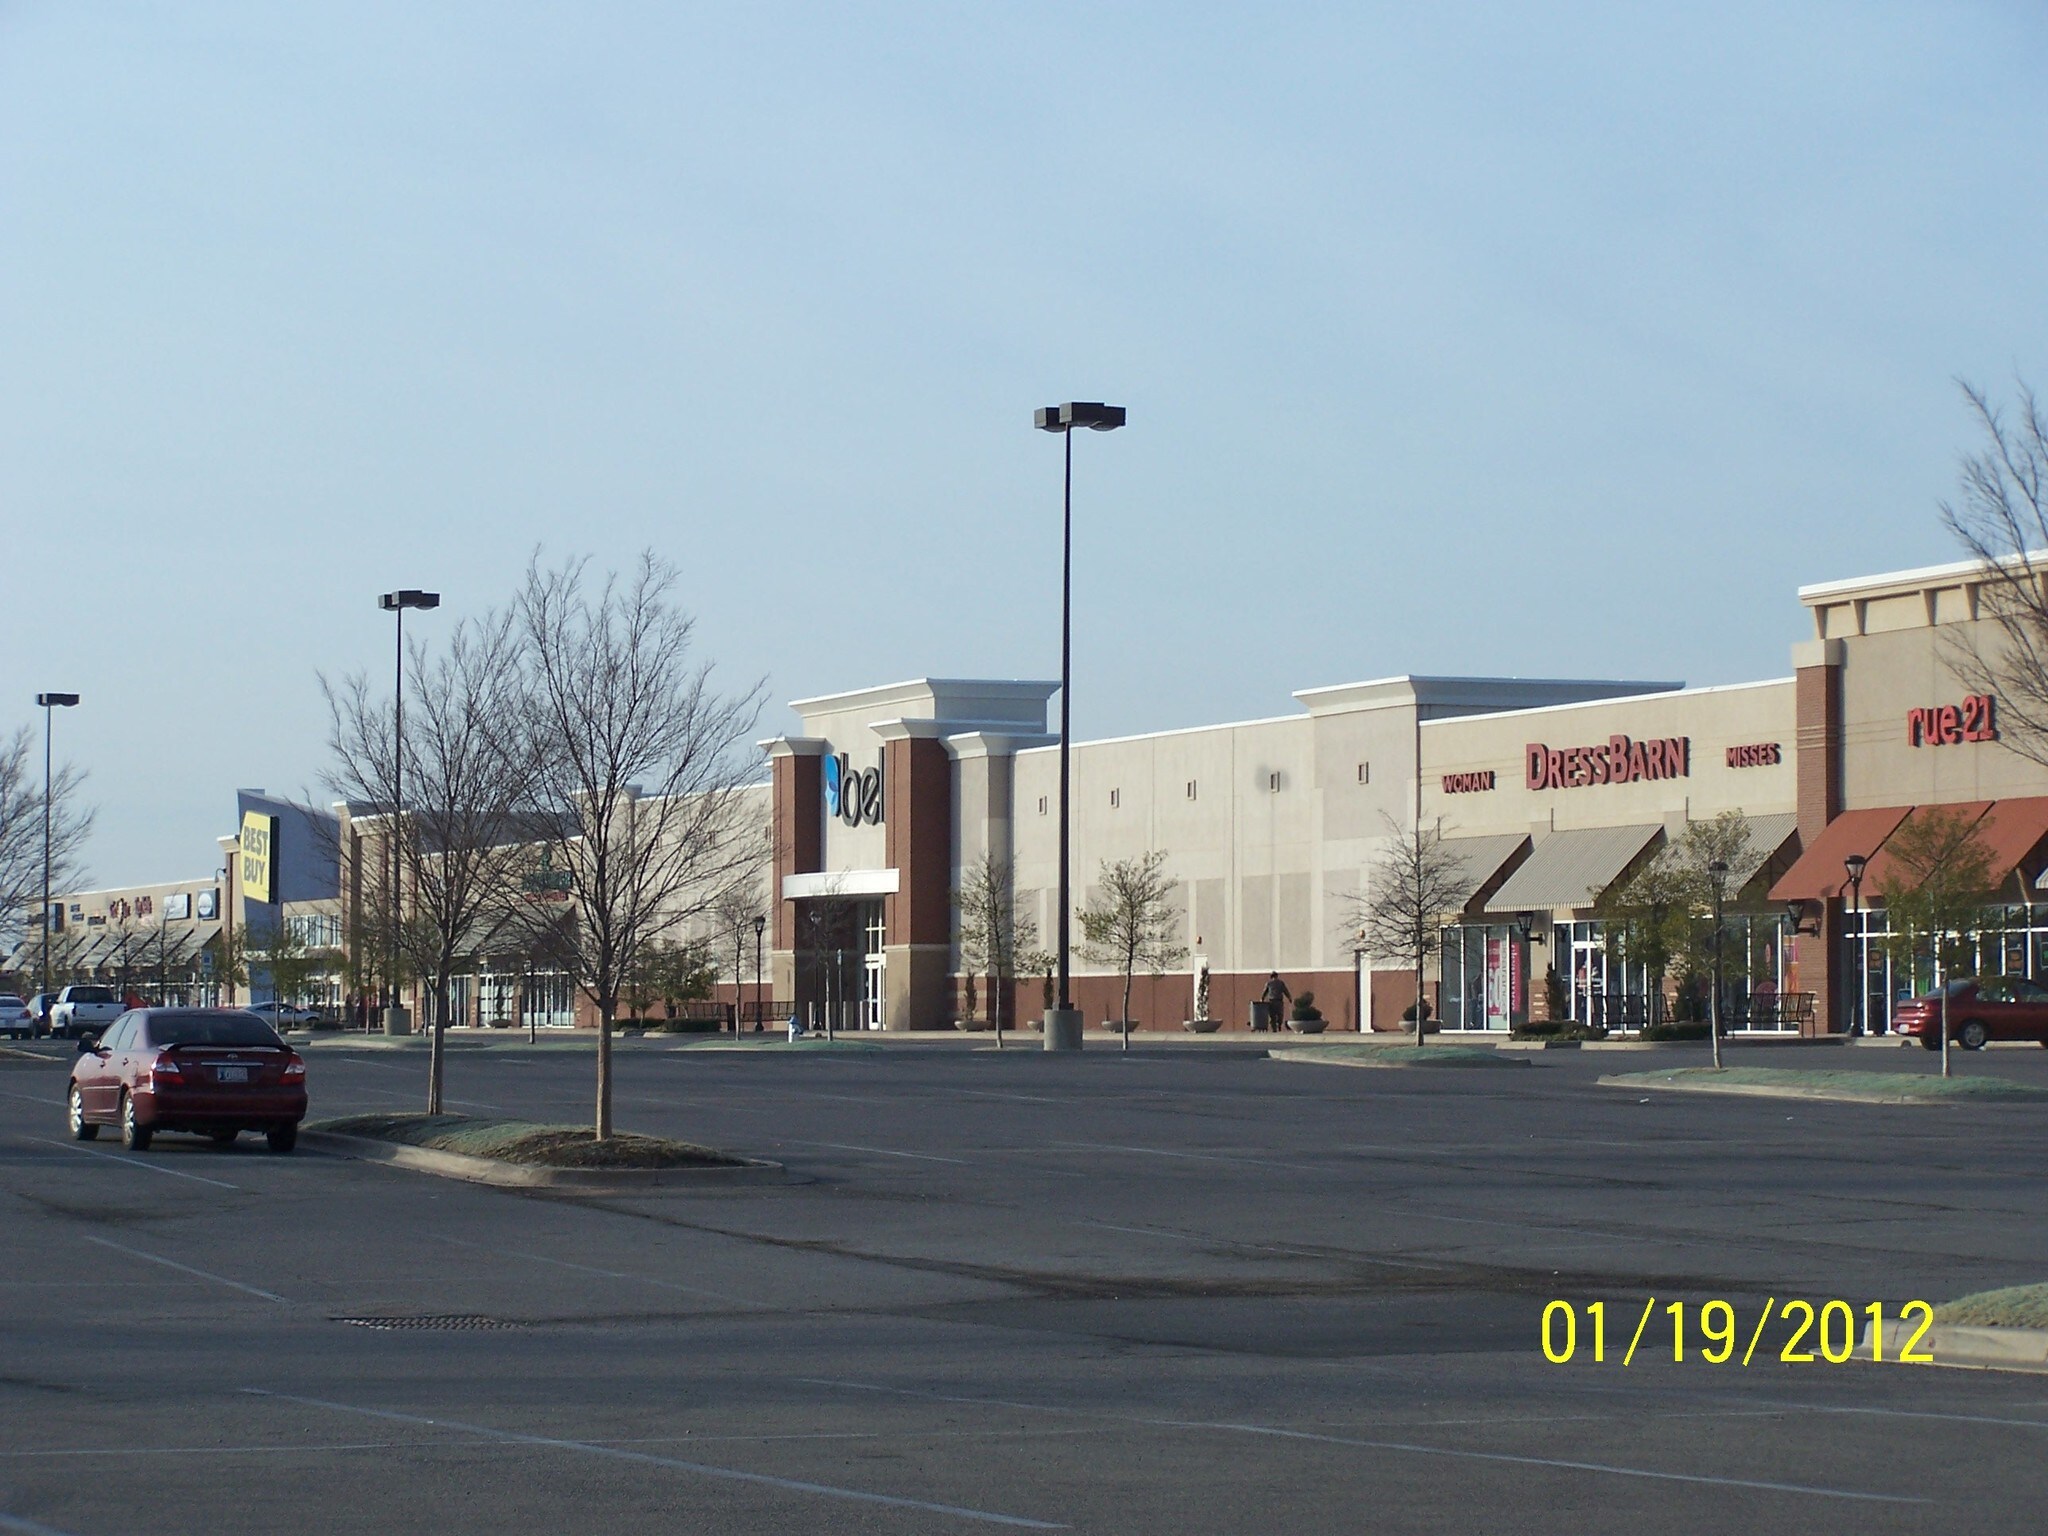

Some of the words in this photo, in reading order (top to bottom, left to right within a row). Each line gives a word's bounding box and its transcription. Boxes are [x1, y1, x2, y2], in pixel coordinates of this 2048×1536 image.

[1726, 743, 1779, 768] MISSES
[1442, 771, 1493, 794] WOMAN
[243, 825, 268, 857] BEST
[243, 855, 266, 886] BUY
